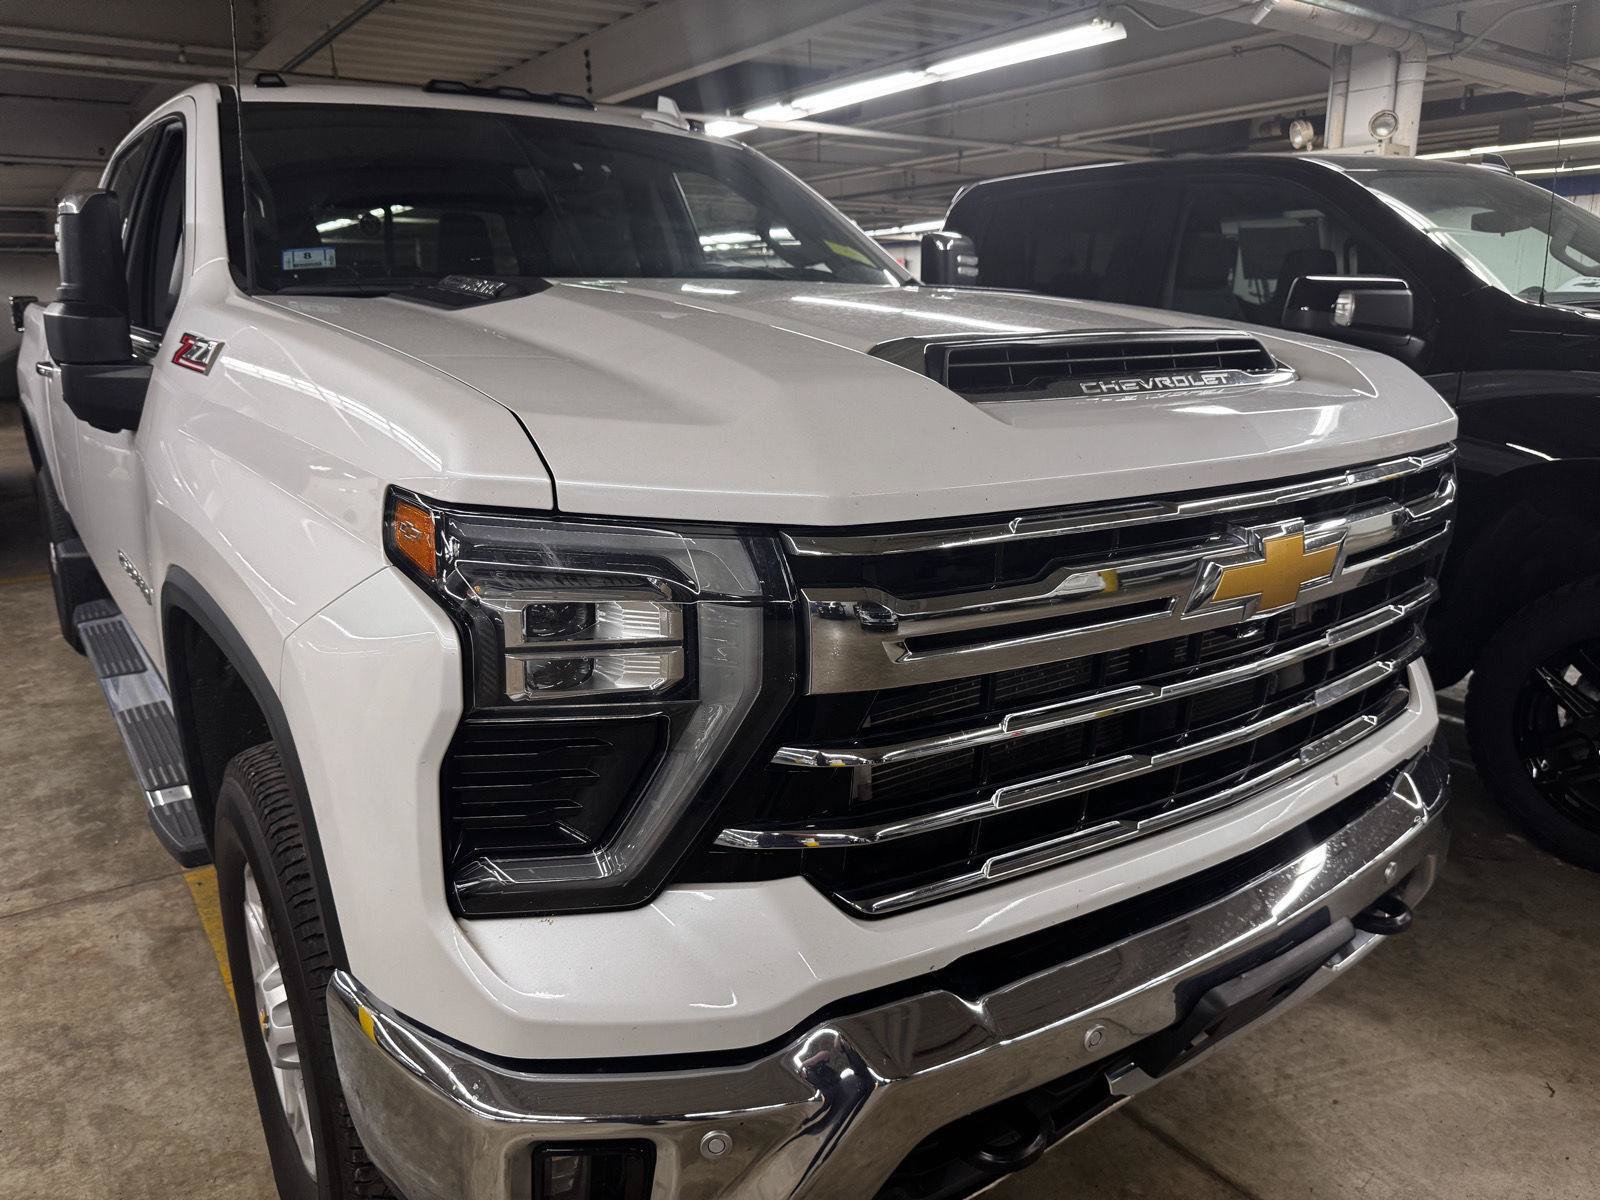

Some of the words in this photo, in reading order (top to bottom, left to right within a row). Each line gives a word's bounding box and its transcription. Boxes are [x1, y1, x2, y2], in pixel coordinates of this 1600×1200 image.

[303, 251, 312, 260] 8
[171, 332, 224, 375] Z71
[1079, 372, 1230, 394] CHEVROLET
